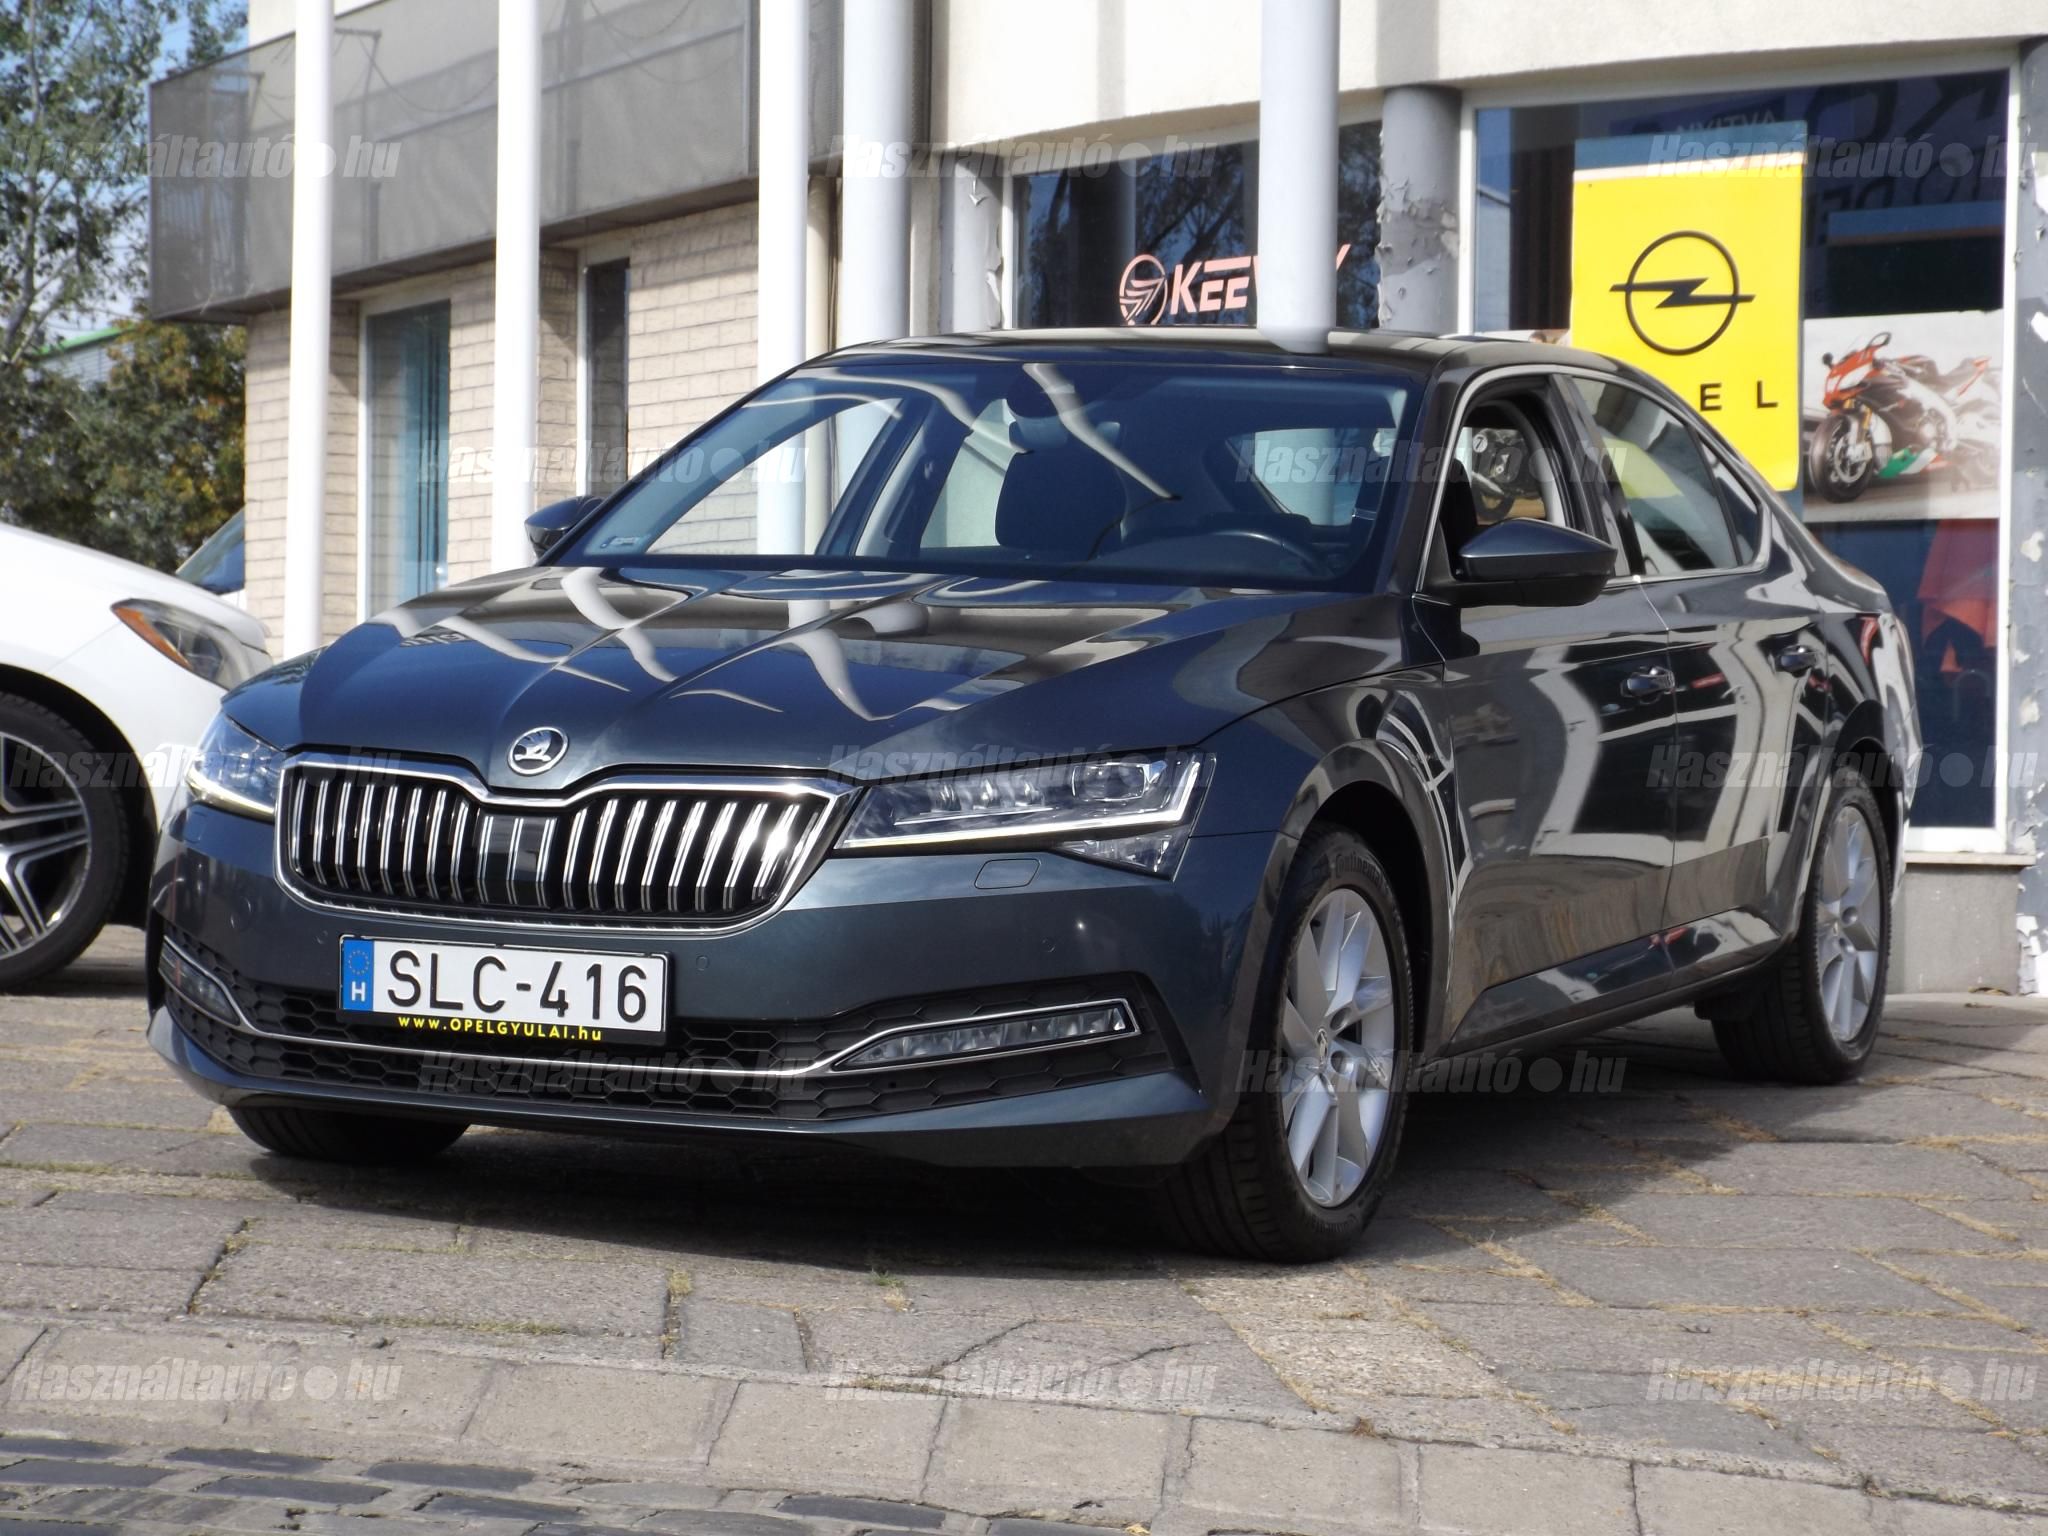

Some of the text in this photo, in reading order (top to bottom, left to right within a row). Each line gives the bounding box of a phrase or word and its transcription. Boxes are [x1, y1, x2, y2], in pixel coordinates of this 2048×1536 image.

[1700, 380, 1779, 412] EL
[351, 981, 366, 1002] H
[387, 949, 647, 1023] SLC-416
[398, 1016, 602, 1041] www.OPELGYULAI.hu
